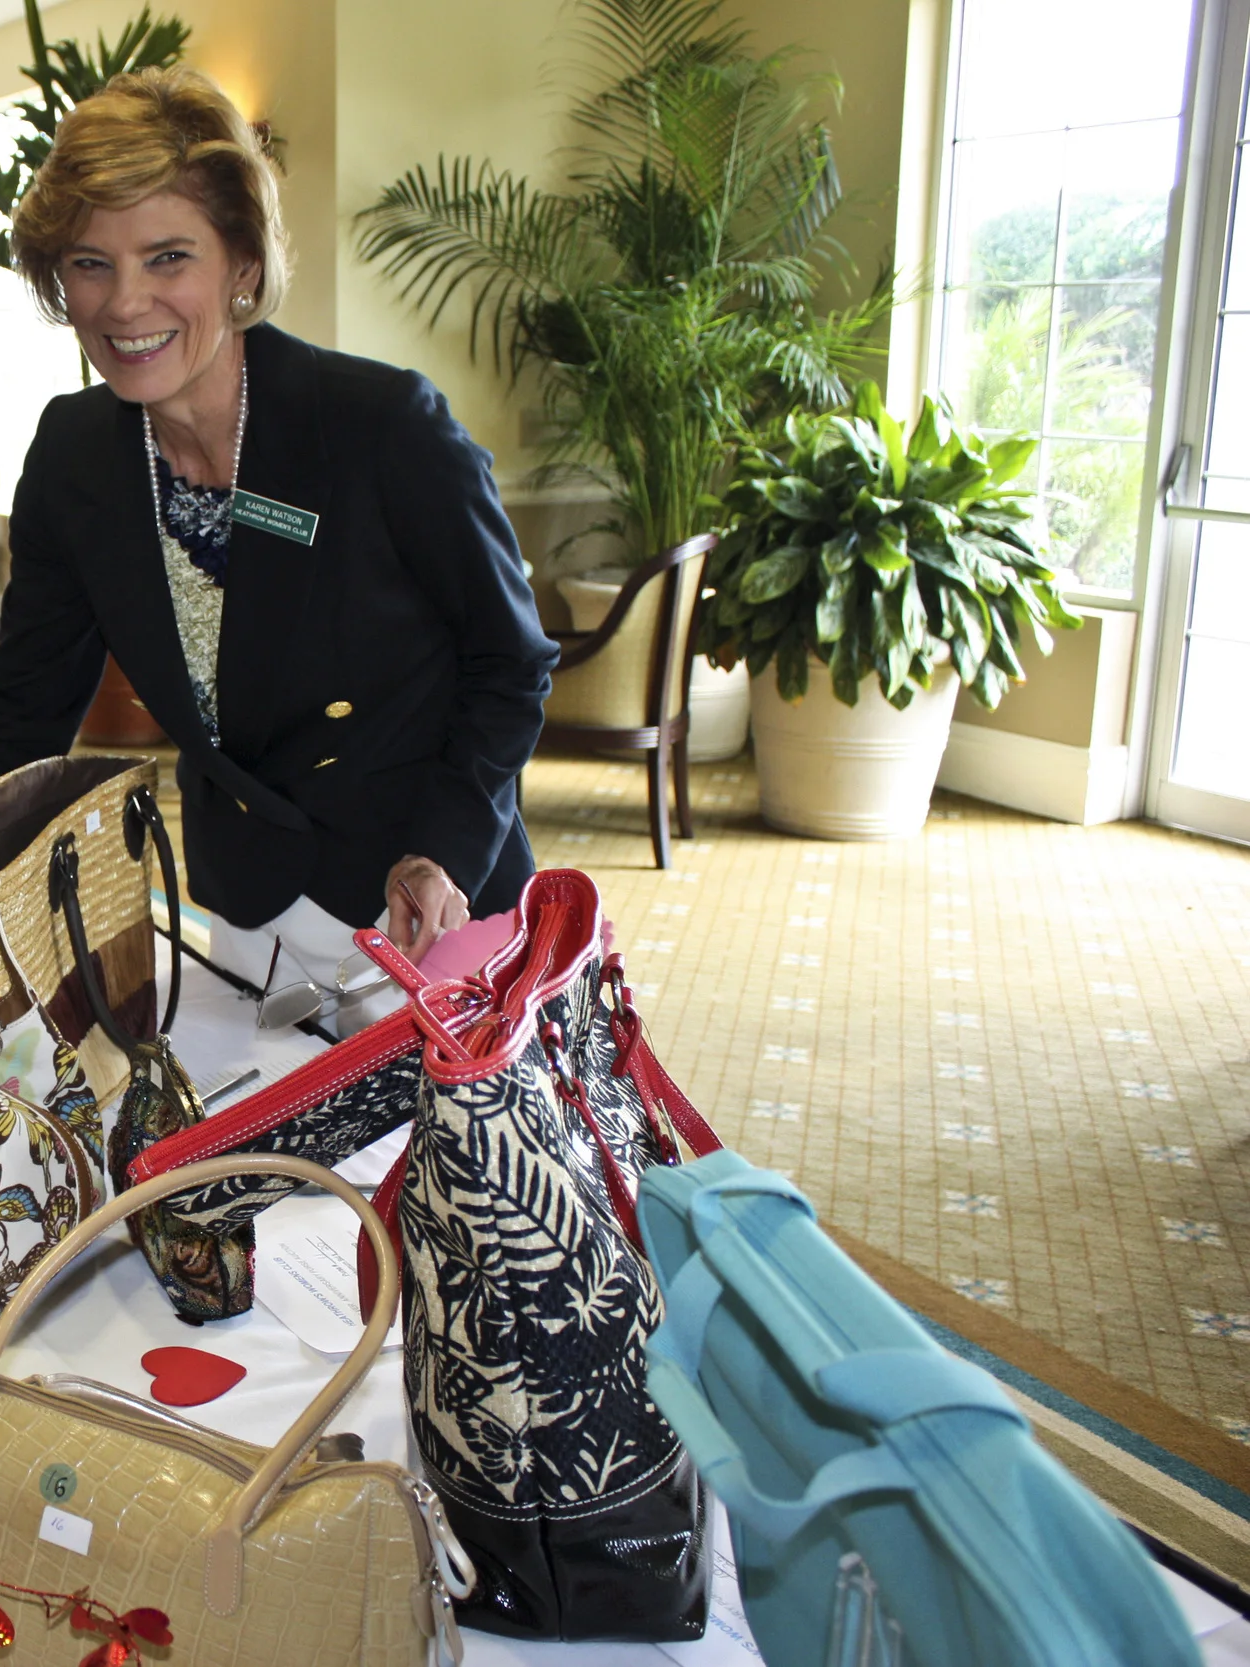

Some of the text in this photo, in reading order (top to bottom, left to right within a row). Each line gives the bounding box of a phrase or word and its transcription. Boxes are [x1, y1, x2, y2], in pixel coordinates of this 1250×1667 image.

[234, 508, 266, 523] HEATHROW
[292, 526, 309, 538] CLUB
[245, 501, 303, 526] KAREN WATSON
[273, 1256, 292, 1271] CLUB
[46, 1469, 68, 1498] 16
[51, 1517, 65, 1531] 16
[708, 1612, 745, 1642] WOME
